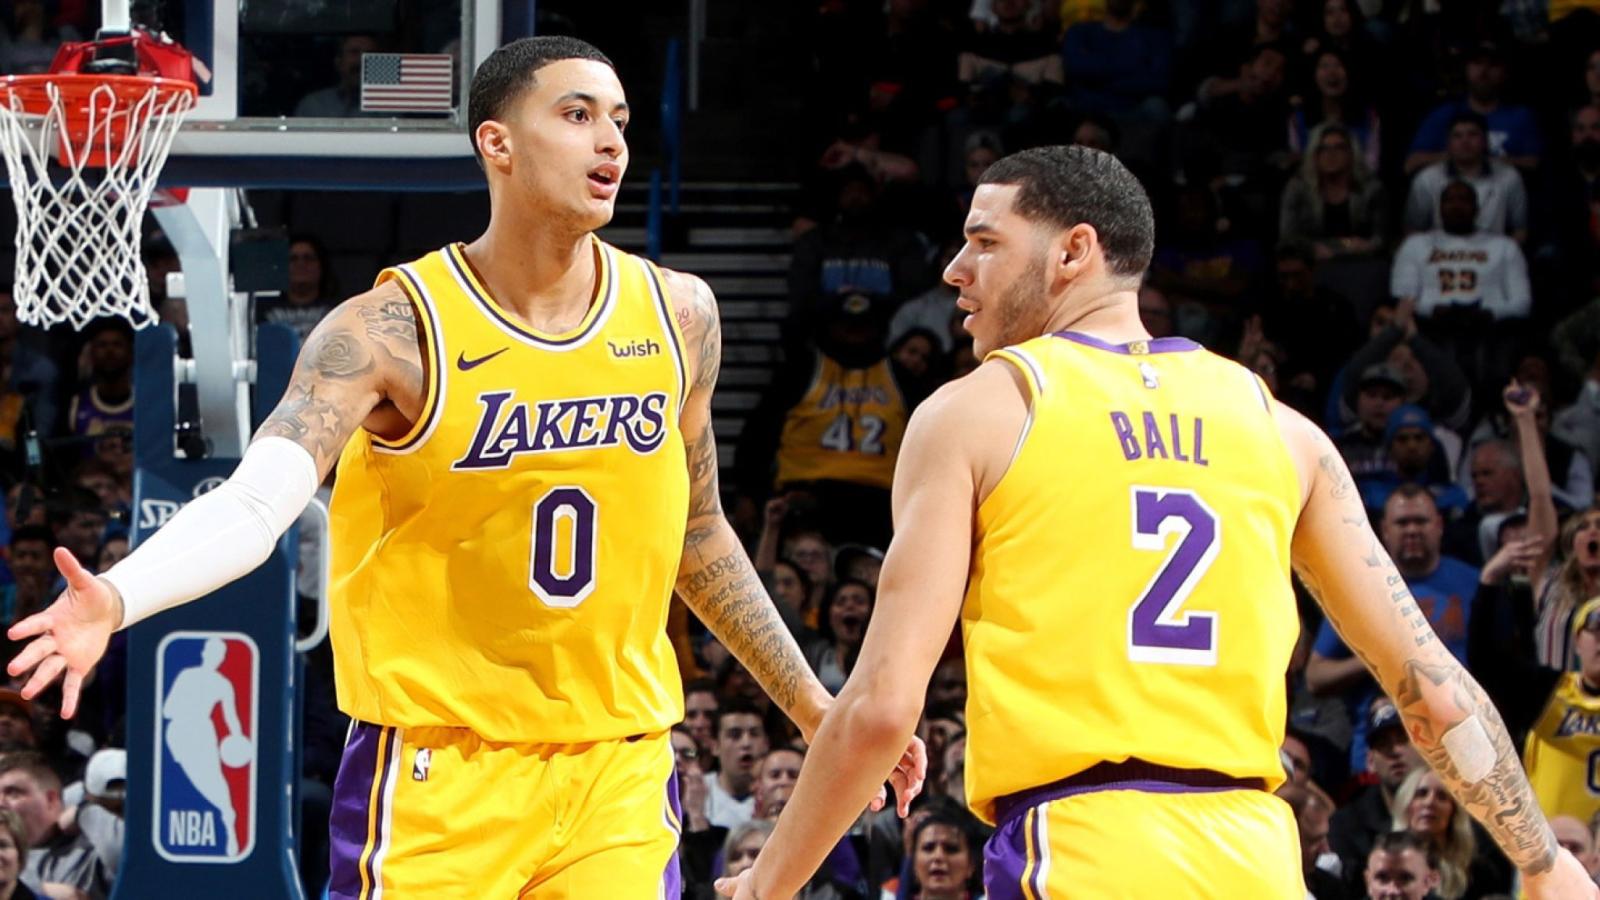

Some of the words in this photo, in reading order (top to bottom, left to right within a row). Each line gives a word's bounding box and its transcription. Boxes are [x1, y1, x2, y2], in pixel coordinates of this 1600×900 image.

[607, 338, 660, 357] wish
[451, 389, 667, 471] LAKERS
[821, 413, 885, 455] 42
[1110, 411, 1209, 466] BALL
[529, 485, 598, 608] 0
[1128, 485, 1221, 666] 2
[169, 810, 216, 847] NBA
